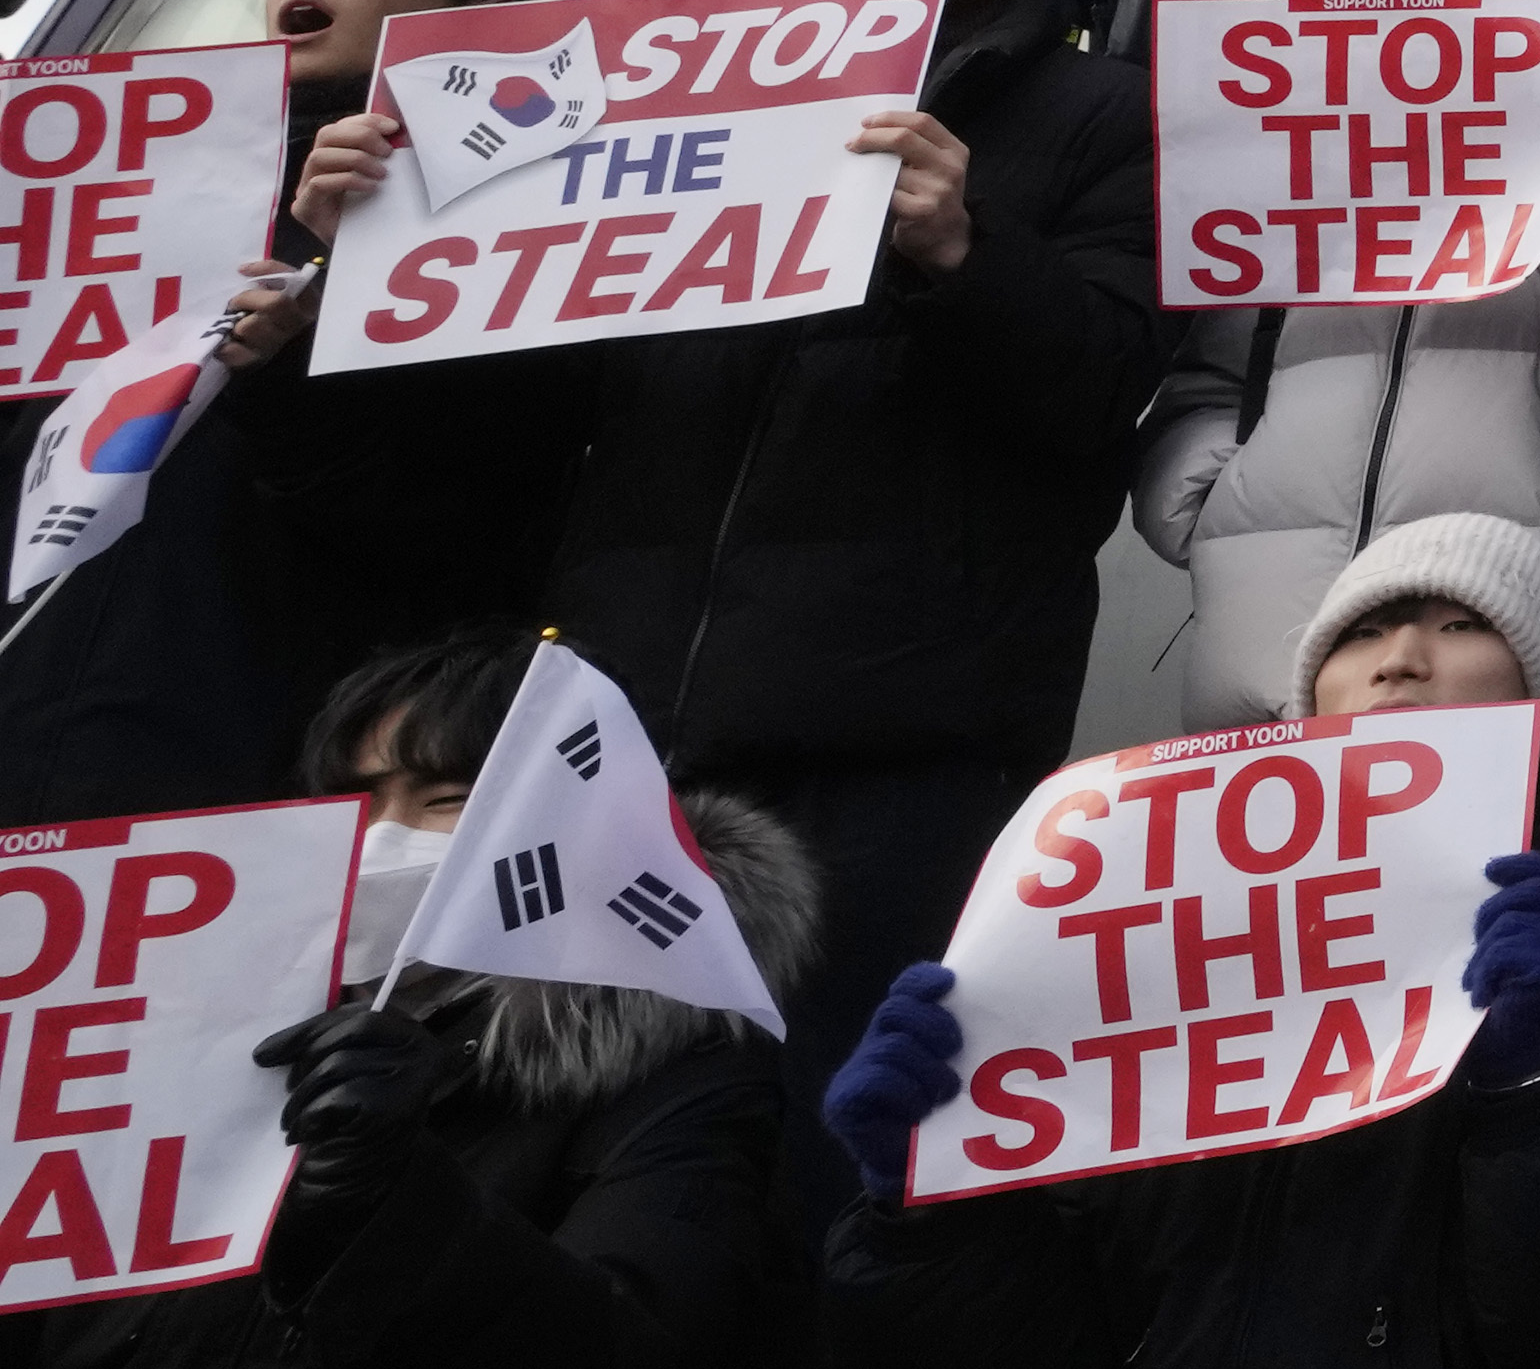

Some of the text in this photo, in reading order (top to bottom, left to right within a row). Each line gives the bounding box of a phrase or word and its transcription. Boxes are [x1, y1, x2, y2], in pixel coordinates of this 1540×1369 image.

[27, 57, 90, 76] YOON
[0, 75, 214, 180] OP
[552, 128, 732, 206] THE
[1261, 110, 1508, 201] THE
[363, 193, 832, 345] STEAL
[1188, 203, 1535, 298] STEAL
[1151, 721, 1304, 763] SUPPORT YOON
[1015, 740, 1444, 909] STOP
[1058, 868, 1387, 1025] THE
[0, 996, 148, 1143] E
[961, 985, 1442, 1171] STEAL
